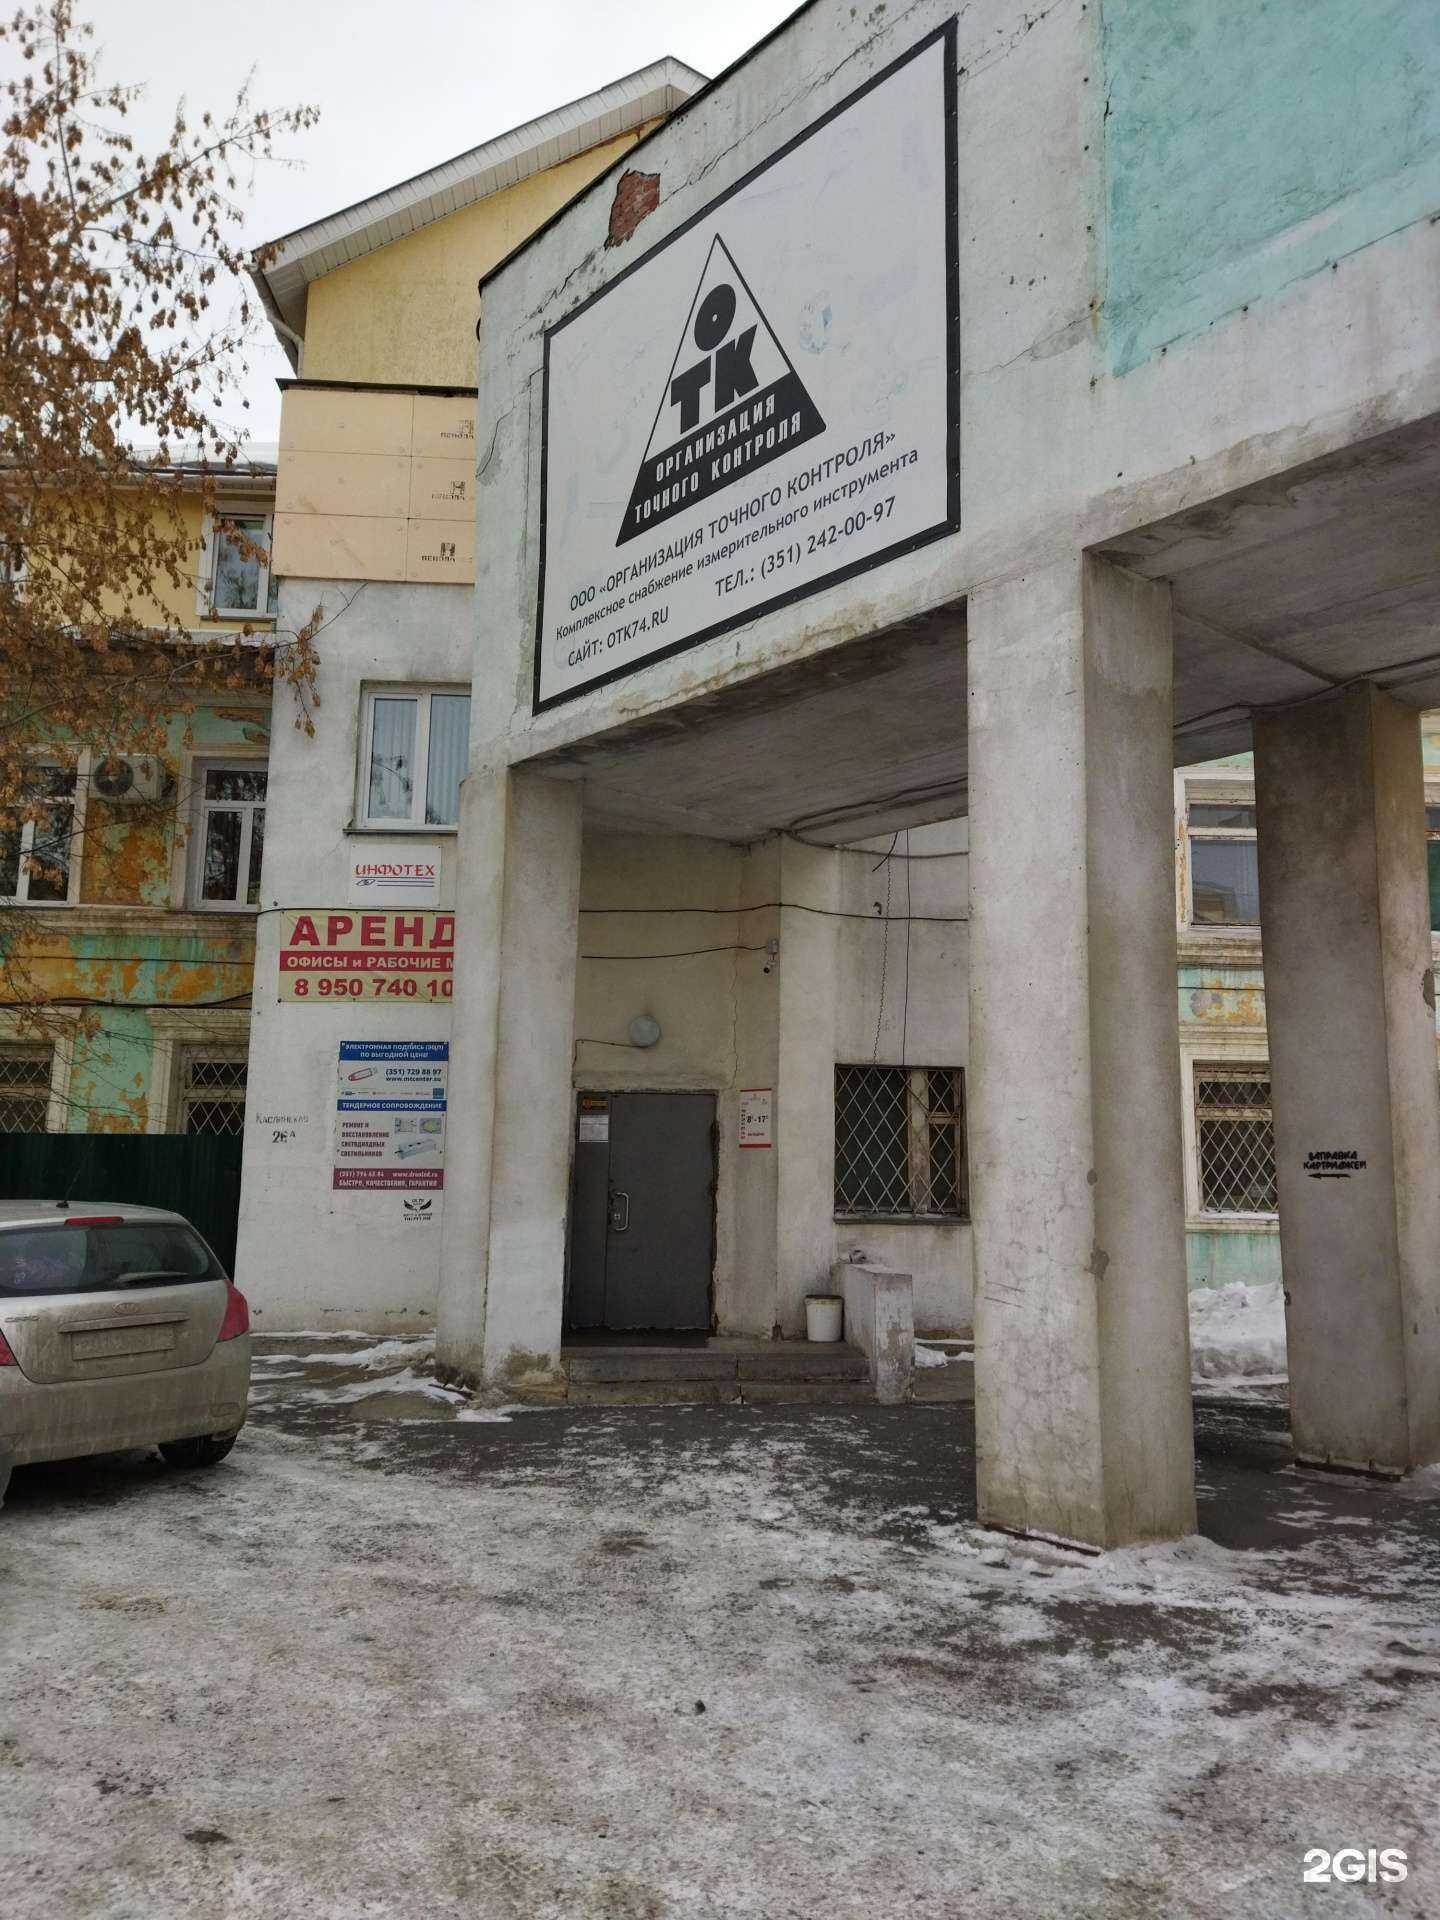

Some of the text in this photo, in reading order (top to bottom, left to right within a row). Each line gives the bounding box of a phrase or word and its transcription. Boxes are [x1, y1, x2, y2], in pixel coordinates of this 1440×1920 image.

[656, 394, 775, 482] ОРГАНИЗАЦИЯ
[635, 411, 801, 523] ТОЧНОГО КОНТРОЛЯ
[570, 432, 895, 611] ООО «ОРГАНИЗАЦИЯ ТОЧНОГО КОНТРОЛЯ»
[556, 449, 918, 640] Комплексное снабжение измерительного инструмента
[715, 496, 895, 597] ТЕЛ.: (351) 242-00-97
[568, 639, 603, 667] САЙТ:
[355, 863, 435, 877] ИНФОТЕХ
[287, 956, 348, 969] ОФИСЫ
[352, 959, 362, 968] и
[366, 957, 441, 969] РАБОЧИЕ
[294, 978, 309, 996] 8
[317, 978, 363, 997] 950
[372, 978, 418, 997] 740
[371, 1051, 409, 1059] ВЫГОДНОЙ
[393, 1043, 425, 1051] ПОДПИСЬ
[385, 1068, 405, 1076] (351)
